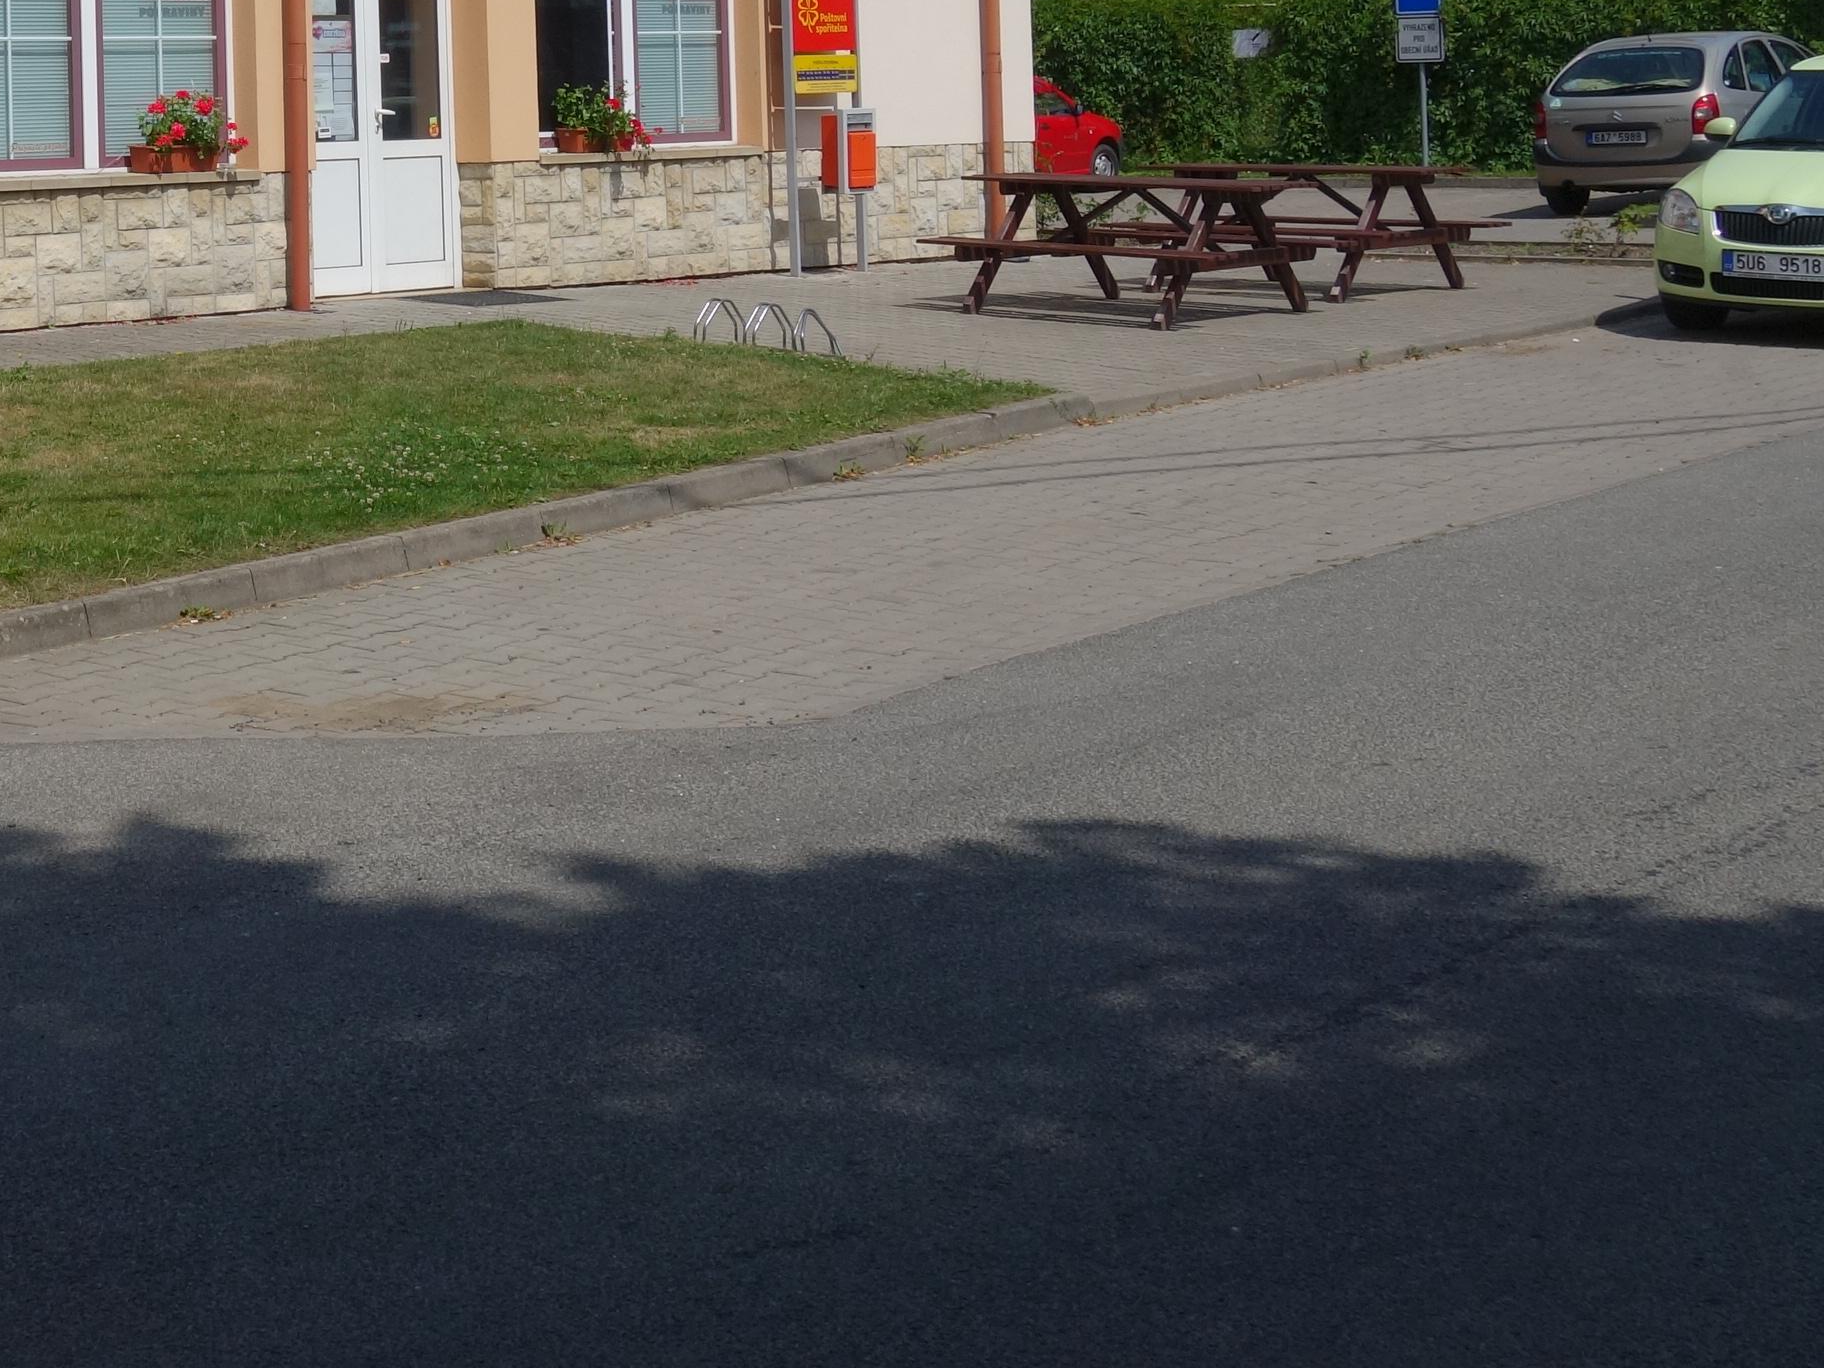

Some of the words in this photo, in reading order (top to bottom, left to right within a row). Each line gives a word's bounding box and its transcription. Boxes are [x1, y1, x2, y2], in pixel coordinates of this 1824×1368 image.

[819, 12, 848, 23] Poštovní
[815, 22, 849, 36] spořitelna
[1736, 254, 1766, 271] 5U6
[1779, 257, 1821, 274] 9518
